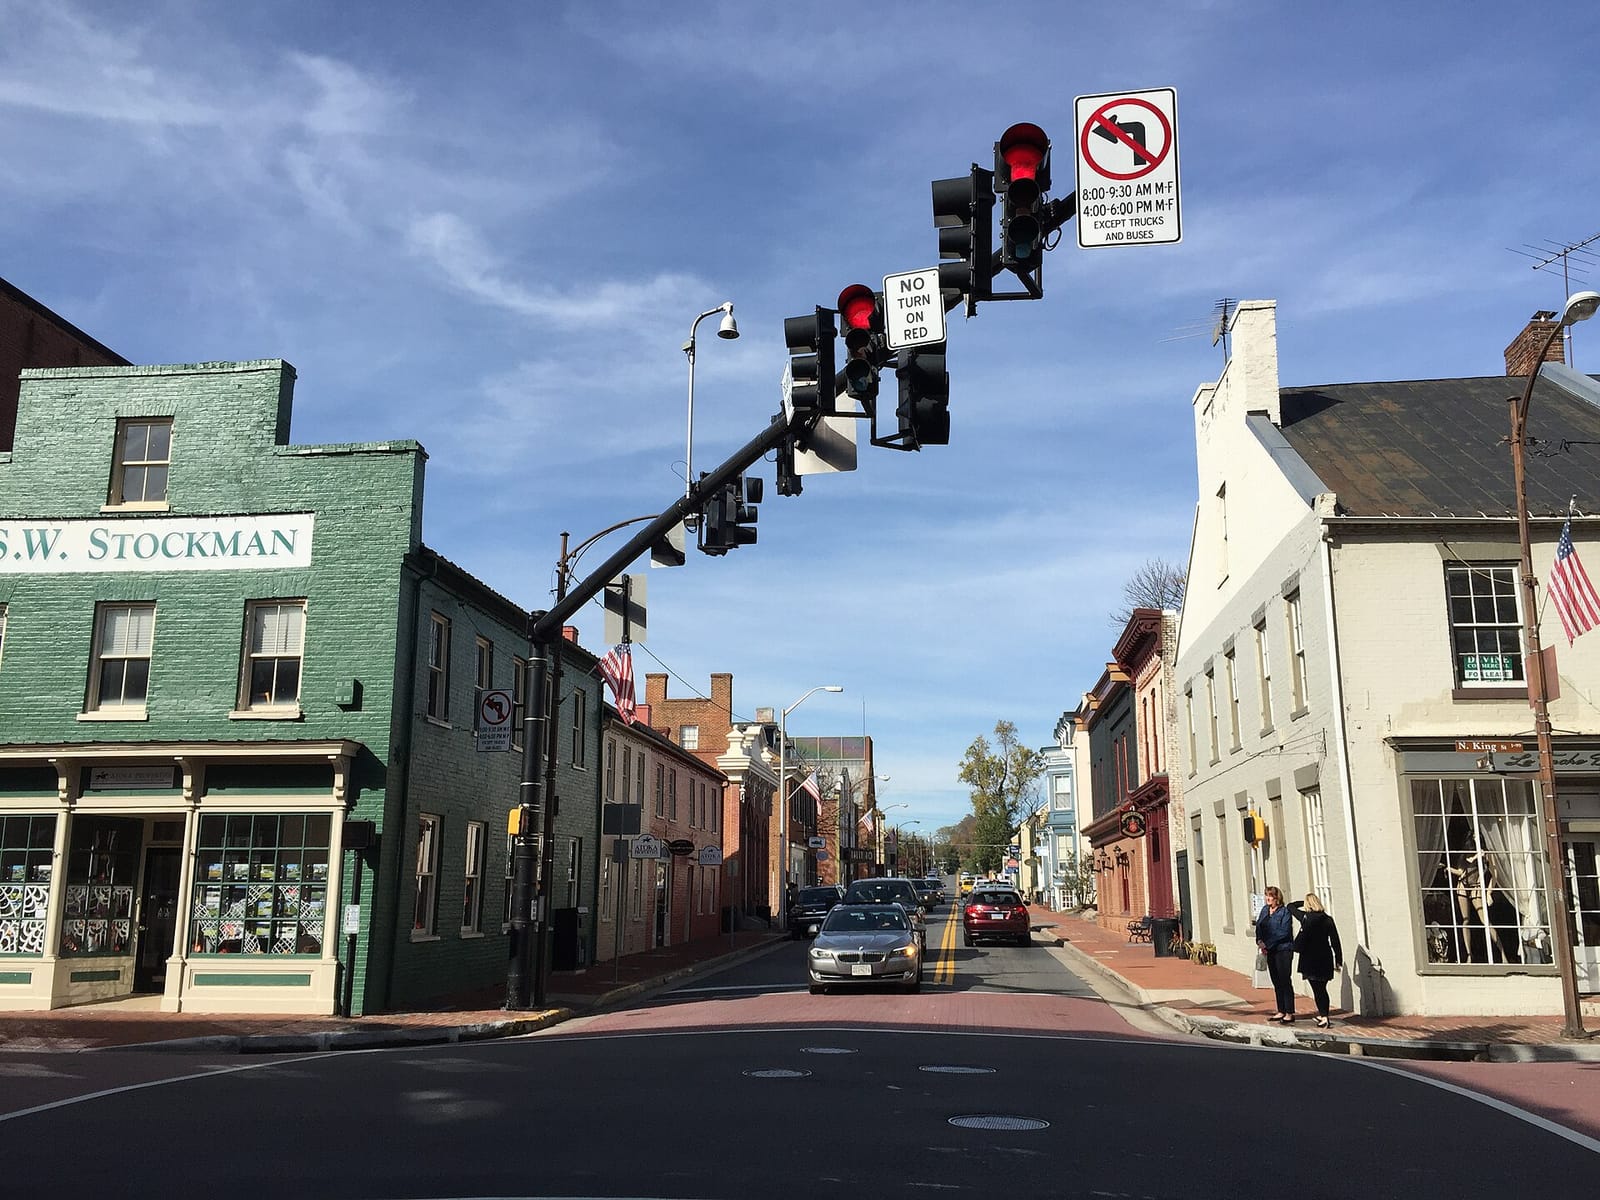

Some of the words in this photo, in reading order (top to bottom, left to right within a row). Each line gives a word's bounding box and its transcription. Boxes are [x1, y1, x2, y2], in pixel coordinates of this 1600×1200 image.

[1082, 184, 1132, 201] 8:00-9:30
[1135, 182, 1152, 197] AM
[1155, 181, 1174, 194] M-F
[1083, 201, 1133, 217] 4:00-6:00
[1136, 200, 1152, 213] PM
[1155, 198, 1175, 211] M-F
[1094, 219, 1126, 230] EXCEPT
[1128, 216, 1164, 227] TRUCKS
[1105, 232, 1124, 241] AND
[1126, 230, 1154, 240] BUSES
[900, 277, 925, 293] NO
[897, 293, 931, 310] TURN
[906, 311, 924, 324] ON
[904, 326, 928, 341] RED
[1467, 655, 1510, 664] DVINE
[1458, 742, 1469, 750] N.
[1472, 742, 1497, 753] King
